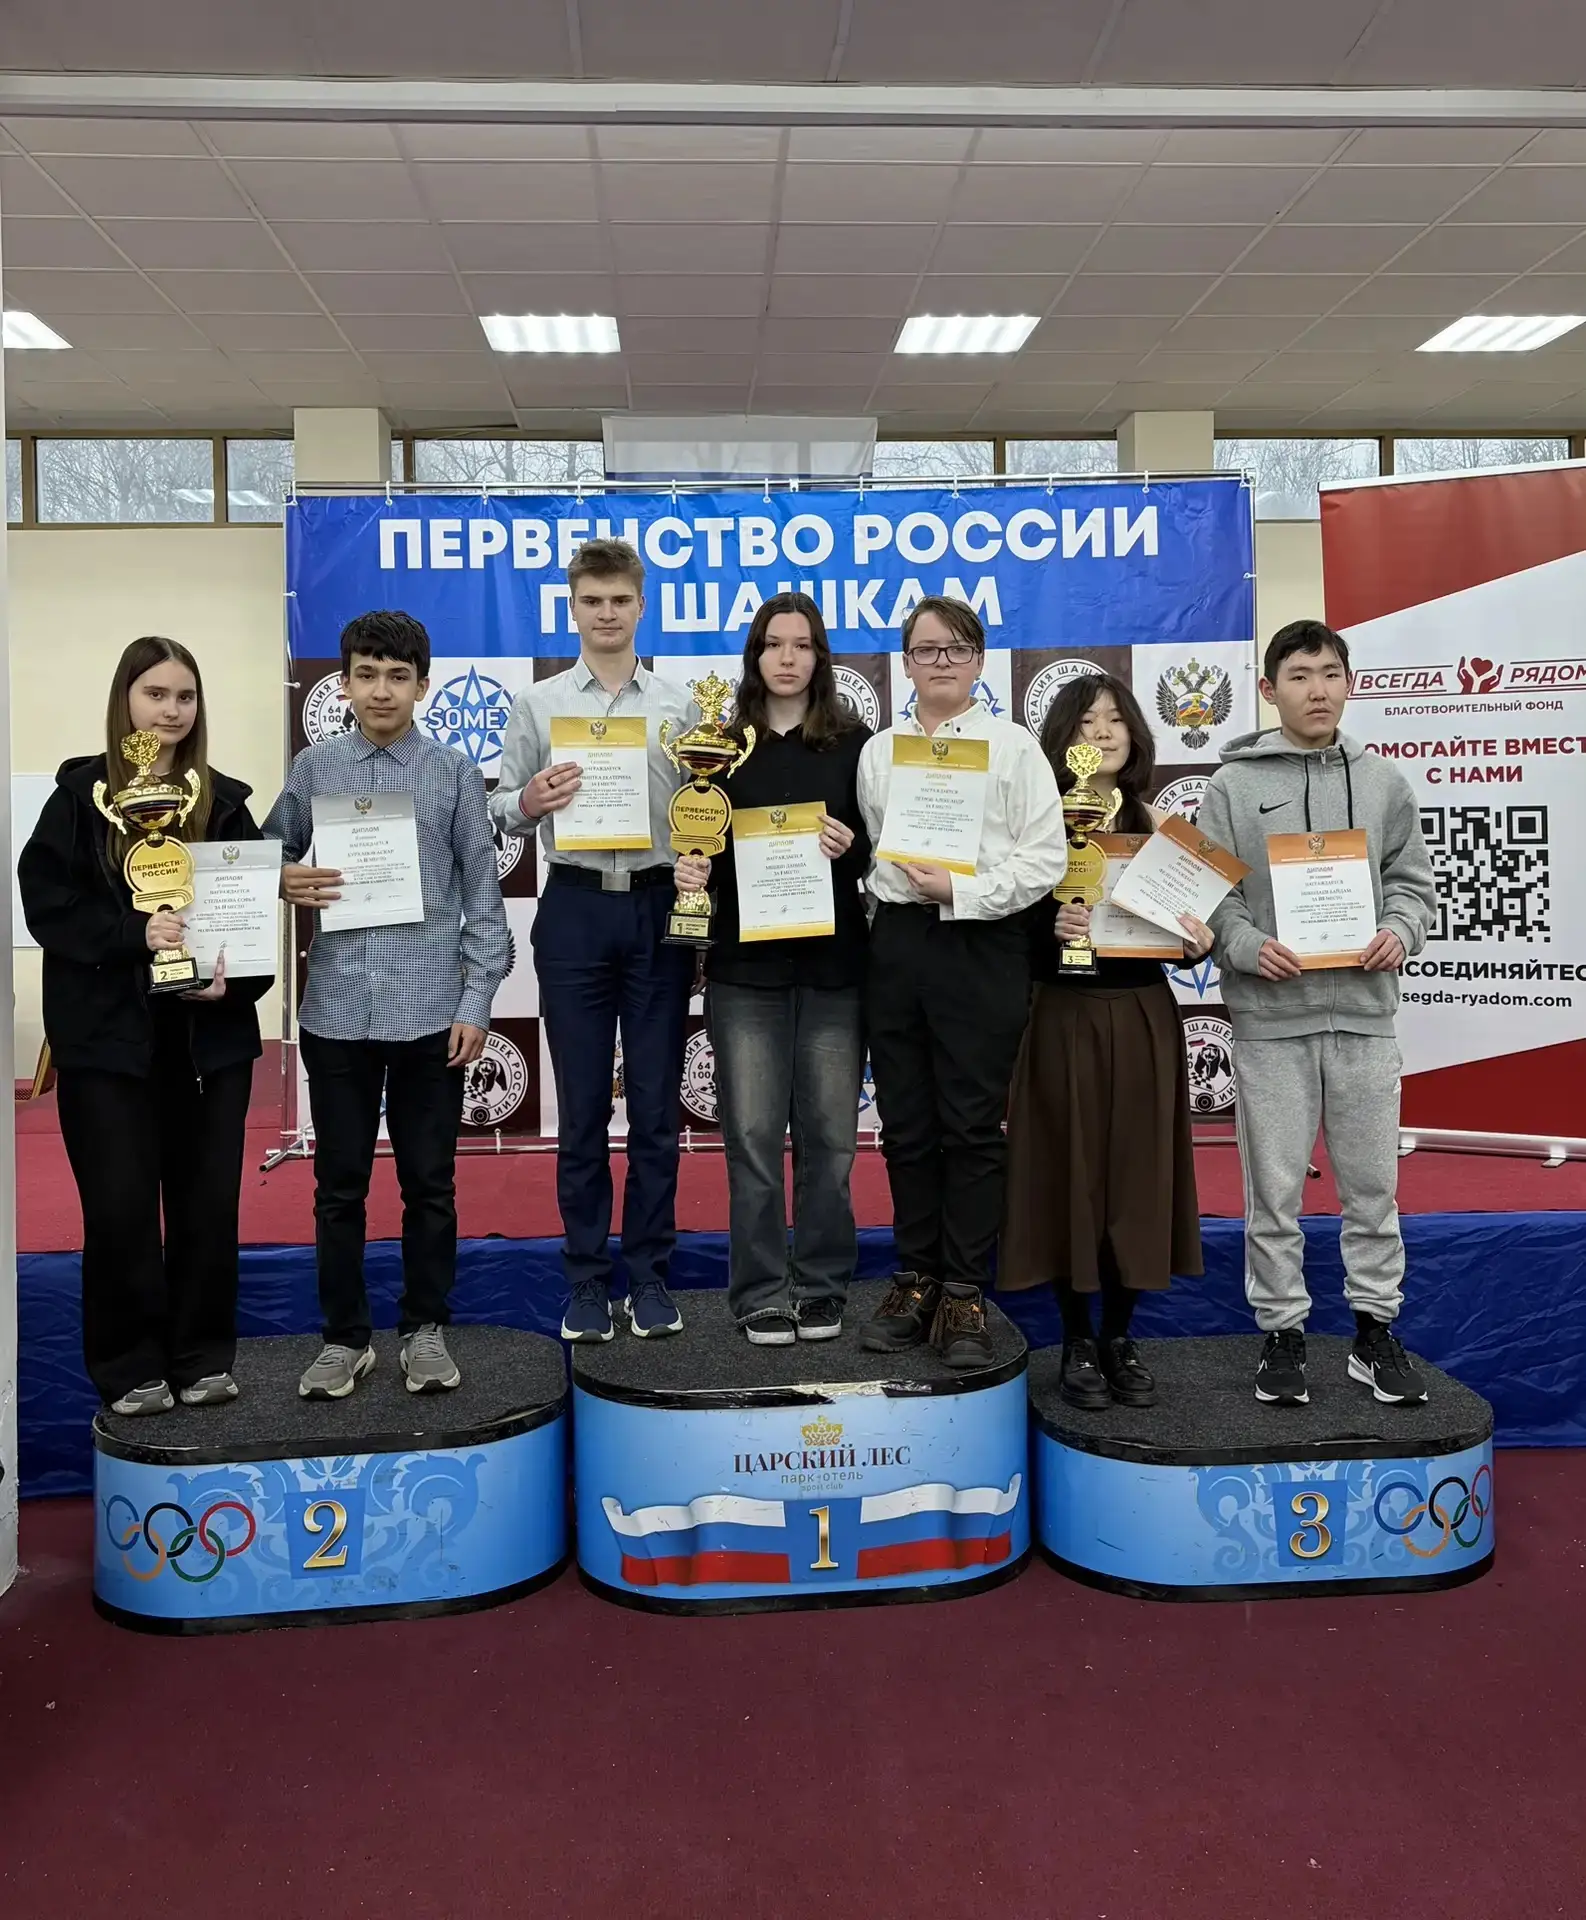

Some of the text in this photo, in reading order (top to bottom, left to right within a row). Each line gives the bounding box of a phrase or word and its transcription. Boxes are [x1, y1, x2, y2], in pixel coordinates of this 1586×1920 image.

[854, 506, 1159, 566] РОССИИ
[1359, 671, 1444, 690] ВСЕГДА
[327, 705, 341, 713] 64
[1384, 700, 1564, 716] БЛАГОТВОРИТЕЛЬНЫЙ ФОНД
[323, 715, 342, 723] 100
[1364, 736, 1586, 759] МОГАЙТЕ ВМЕСТ
[1426, 765, 1523, 784] С НАМИ
[675, 805, 725, 815] ПЕРВЕНСТВО
[683, 813, 716, 822] РОССИИ
[131, 859, 187, 872] ПЕРВЕНСТВО
[141, 867, 179, 878] РОССИИ
[677, 922, 683, 934] 1
[1067, 956, 1074, 964] 3
[160, 971, 168, 981] 2
[1399, 959, 1586, 981] СОЕДИНЯЙТЕС
[1399, 990, 1572, 1007] segda-ryadom.com
[697, 1062, 711, 1070] 64
[692, 1071, 711, 1079] 100
[494, 1062, 522, 1116] РОССИИ
[734, 1443, 911, 1476] ЦАРСКИЙ ЛЕС
[781, 1471, 864, 1484] парк-отель
[825, 1482, 843, 1490] club
[1289, 1491, 1333, 1559] 3
[302, 1499, 349, 1569] 2
[808, 1505, 841, 1569] 1
